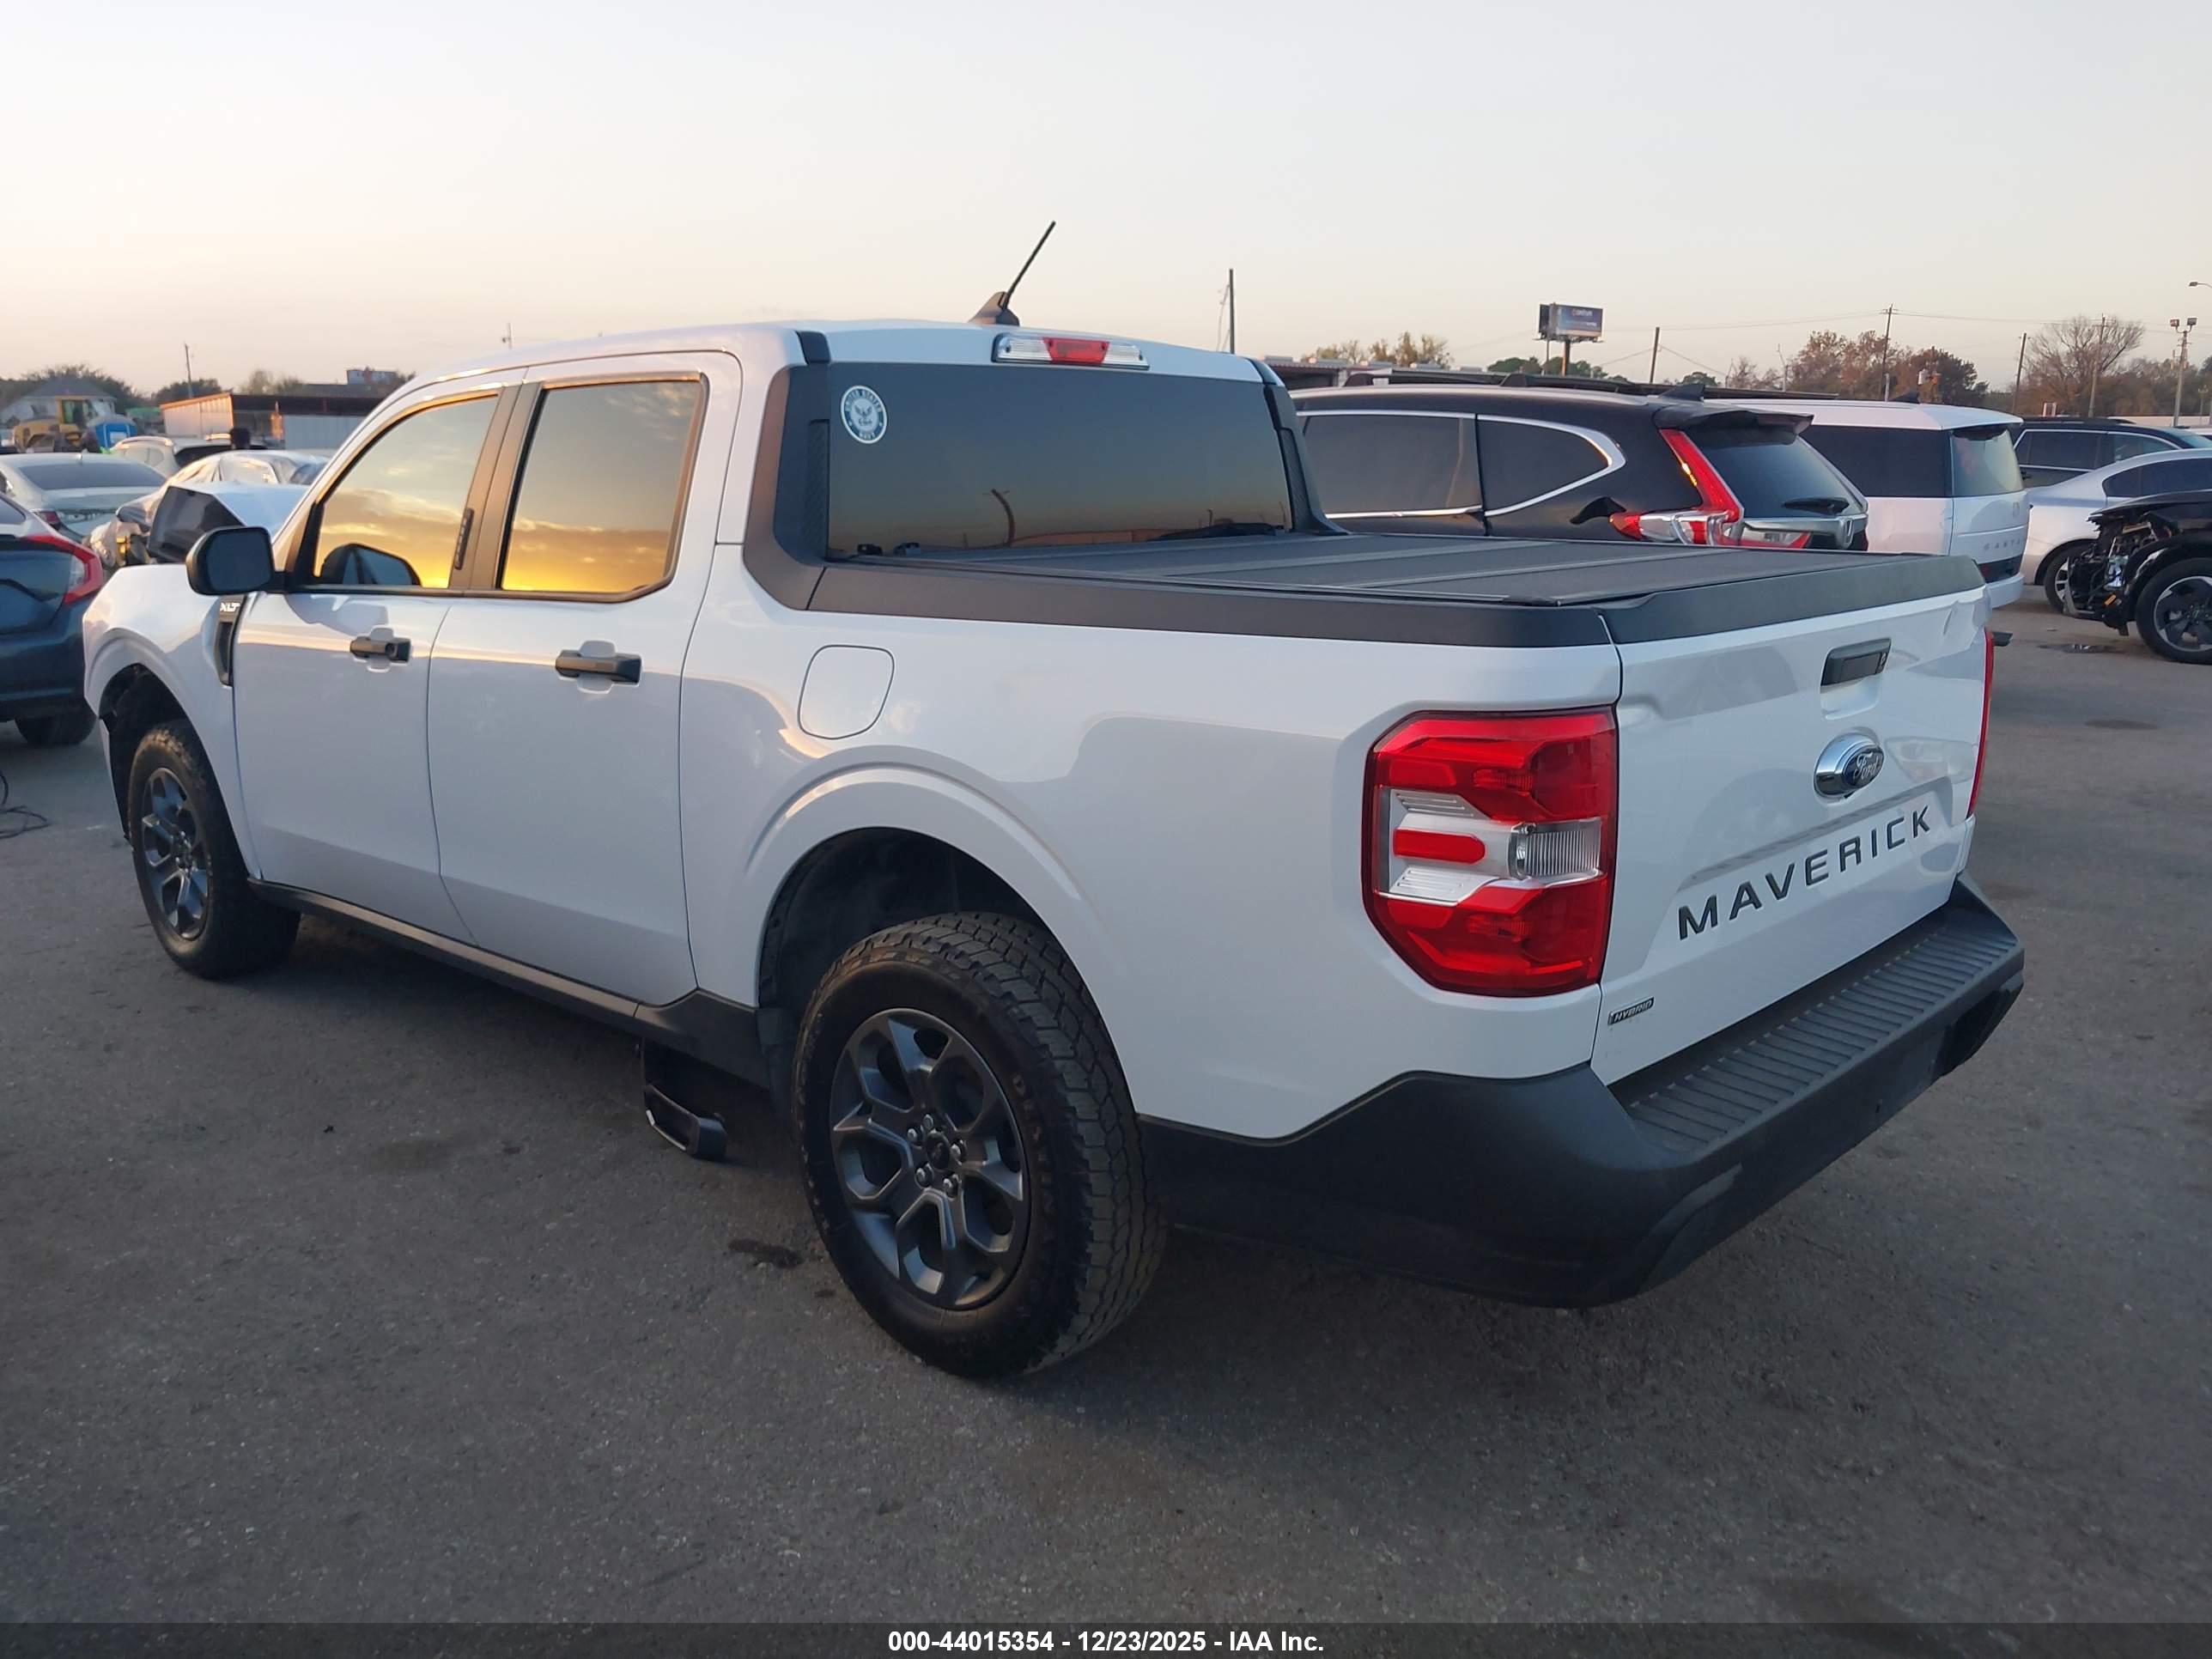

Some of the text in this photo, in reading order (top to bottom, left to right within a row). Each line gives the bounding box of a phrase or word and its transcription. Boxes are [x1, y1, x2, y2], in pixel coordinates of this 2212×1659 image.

[220, 602, 240, 612] XLT
[1853, 751, 1879, 780] Ford
[1678, 805, 1930, 940] MAVERICK
[1613, 1000, 1652, 1022] HYBRID
